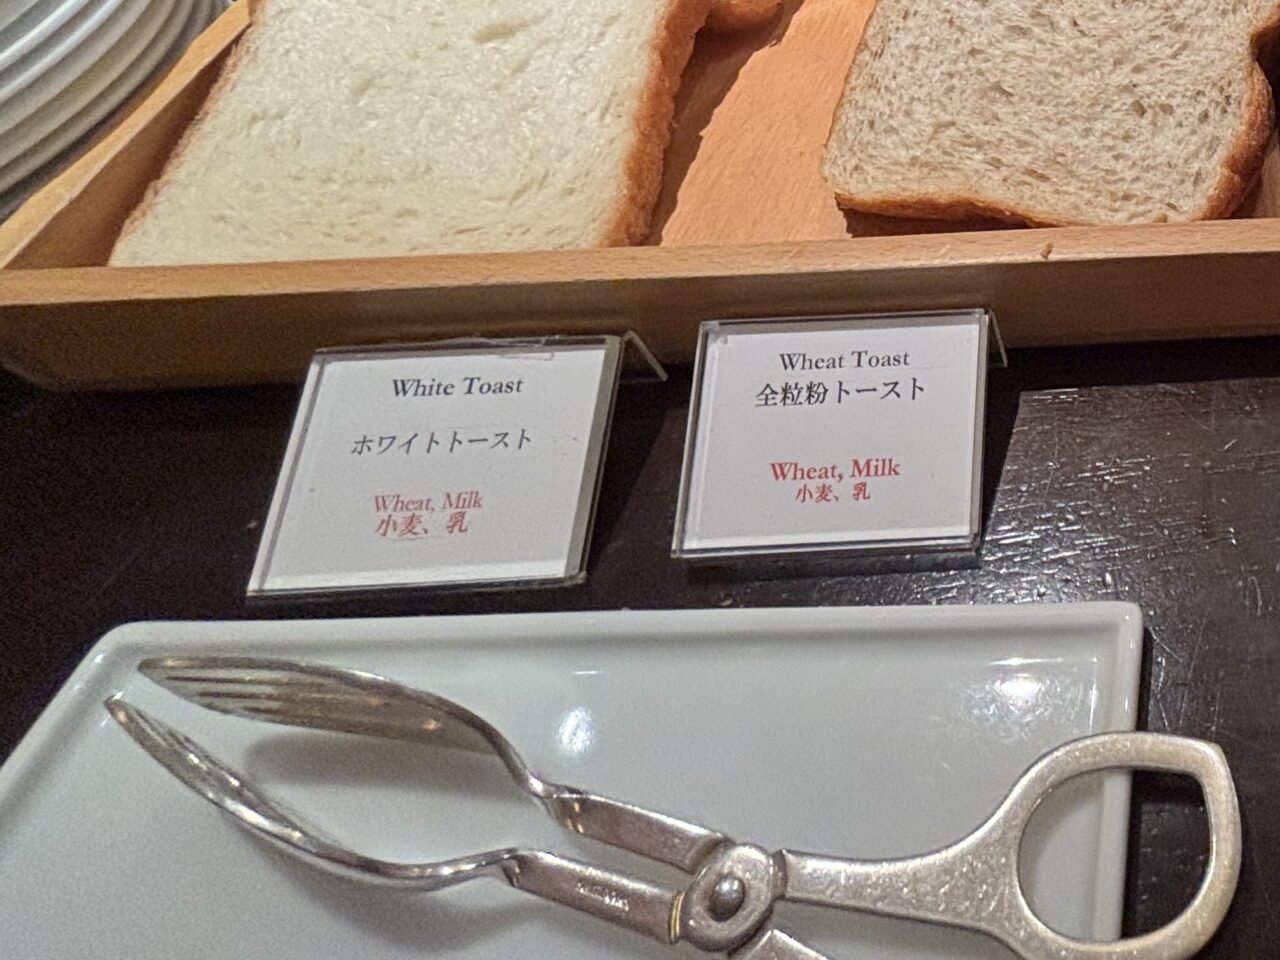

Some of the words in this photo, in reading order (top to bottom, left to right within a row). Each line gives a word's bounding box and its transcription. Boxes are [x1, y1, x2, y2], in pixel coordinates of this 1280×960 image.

[780, 352, 846, 372] Wheat
[850, 349, 911, 369] Toast
[392, 377, 455, 398] White
[461, 376, 525, 396] Toast
[754, 377, 926, 407] 全粒粉トースト
[350, 427, 533, 457] ホワイトトースト
[769, 460, 845, 483] Wheat,
[850, 457, 902, 479] Milk
[374, 493, 436, 513] Wheat,
[441, 490, 484, 511] Milk
[795, 481, 871, 504] 小麦、乳
[375, 510, 470, 538] 小麦、乳
